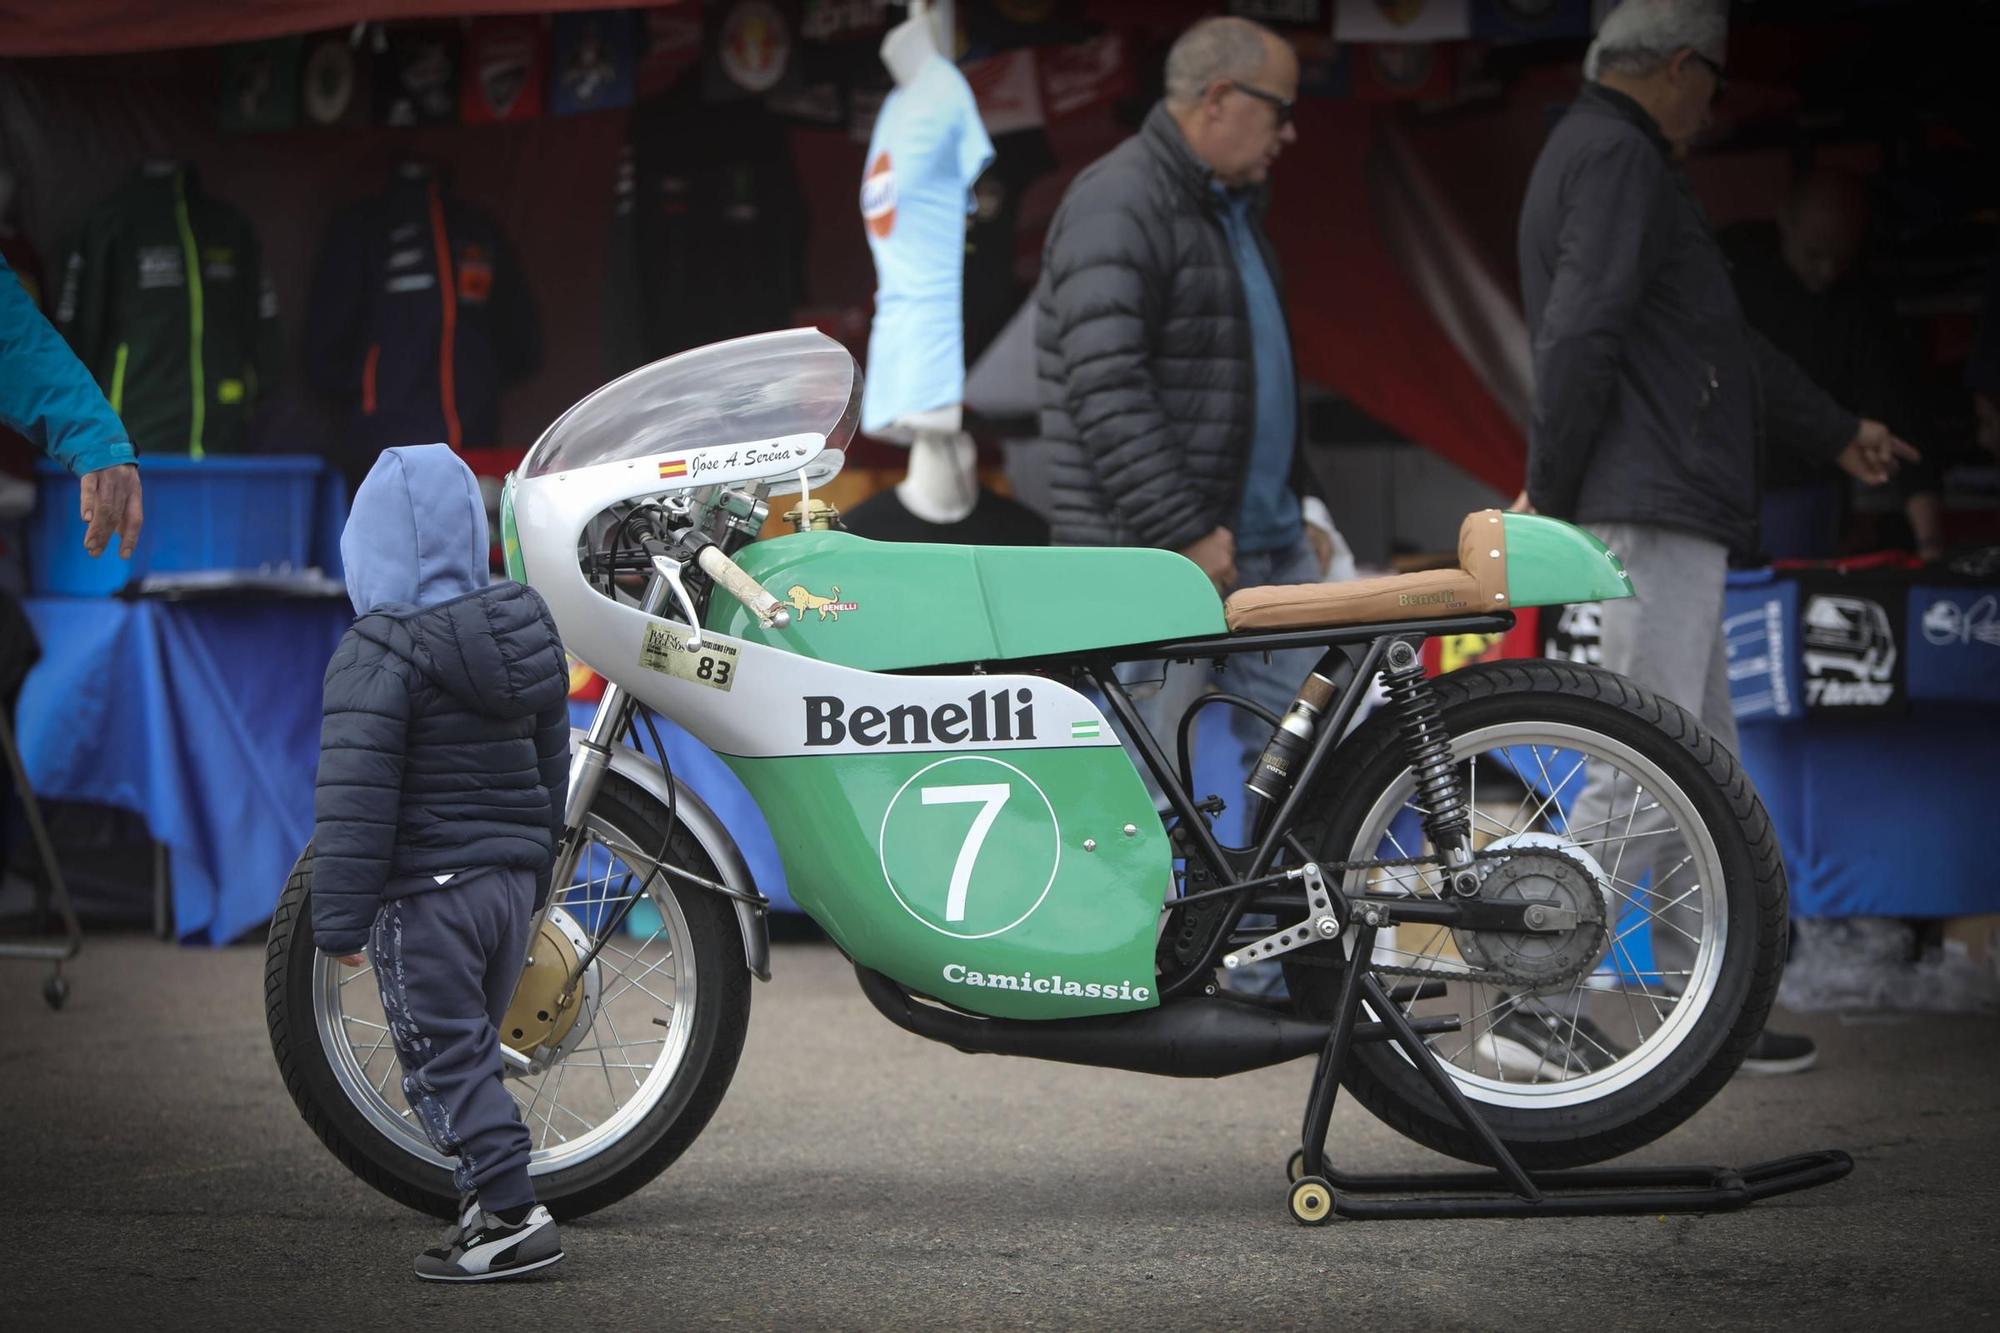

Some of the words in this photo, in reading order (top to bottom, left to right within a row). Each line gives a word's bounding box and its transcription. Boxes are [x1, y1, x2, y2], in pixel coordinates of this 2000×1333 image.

[692, 456, 719, 478] Jose
[744, 450, 791, 467] Serena
[822, 603, 857, 611] BENELLI
[1399, 589, 1456, 607] Benelli
[696, 656, 732, 685] 83
[803, 688, 1037, 746] Benelli
[921, 783, 1011, 921] 7
[942, 964, 1150, 1001] Camiclassic
